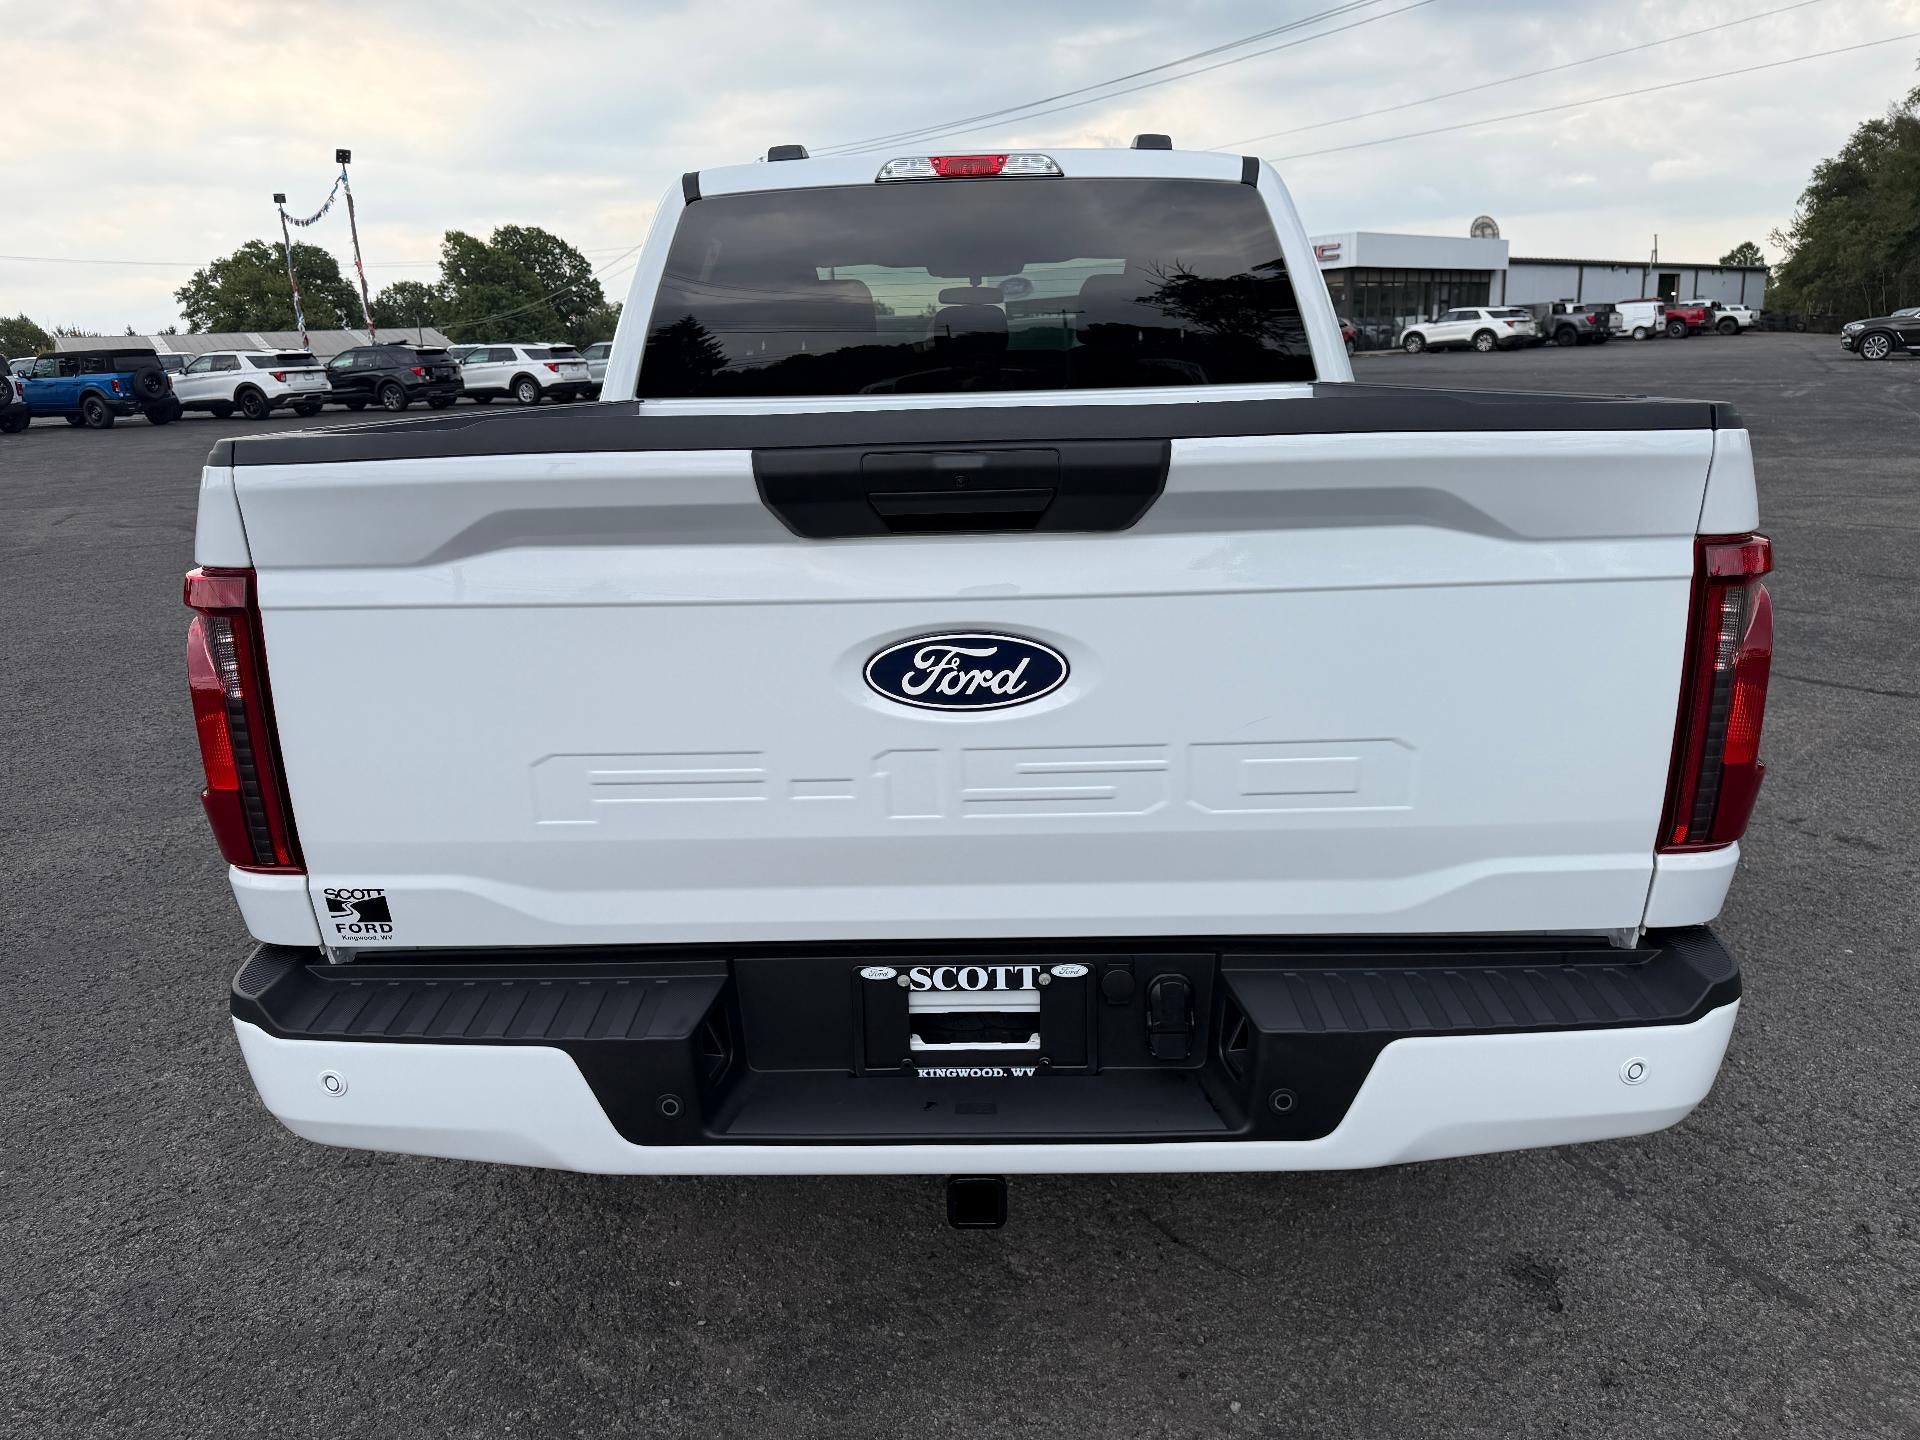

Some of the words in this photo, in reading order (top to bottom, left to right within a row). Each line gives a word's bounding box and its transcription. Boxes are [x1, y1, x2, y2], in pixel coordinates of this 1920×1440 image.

[901, 645, 1031, 696] Ford
[529, 738, 1416, 825] F-150
[323, 888, 385, 900] SCOTT
[335, 923, 393, 933] FORD
[909, 965, 1041, 991] SCOTT
[1010, 1067, 1036, 1077] WV
